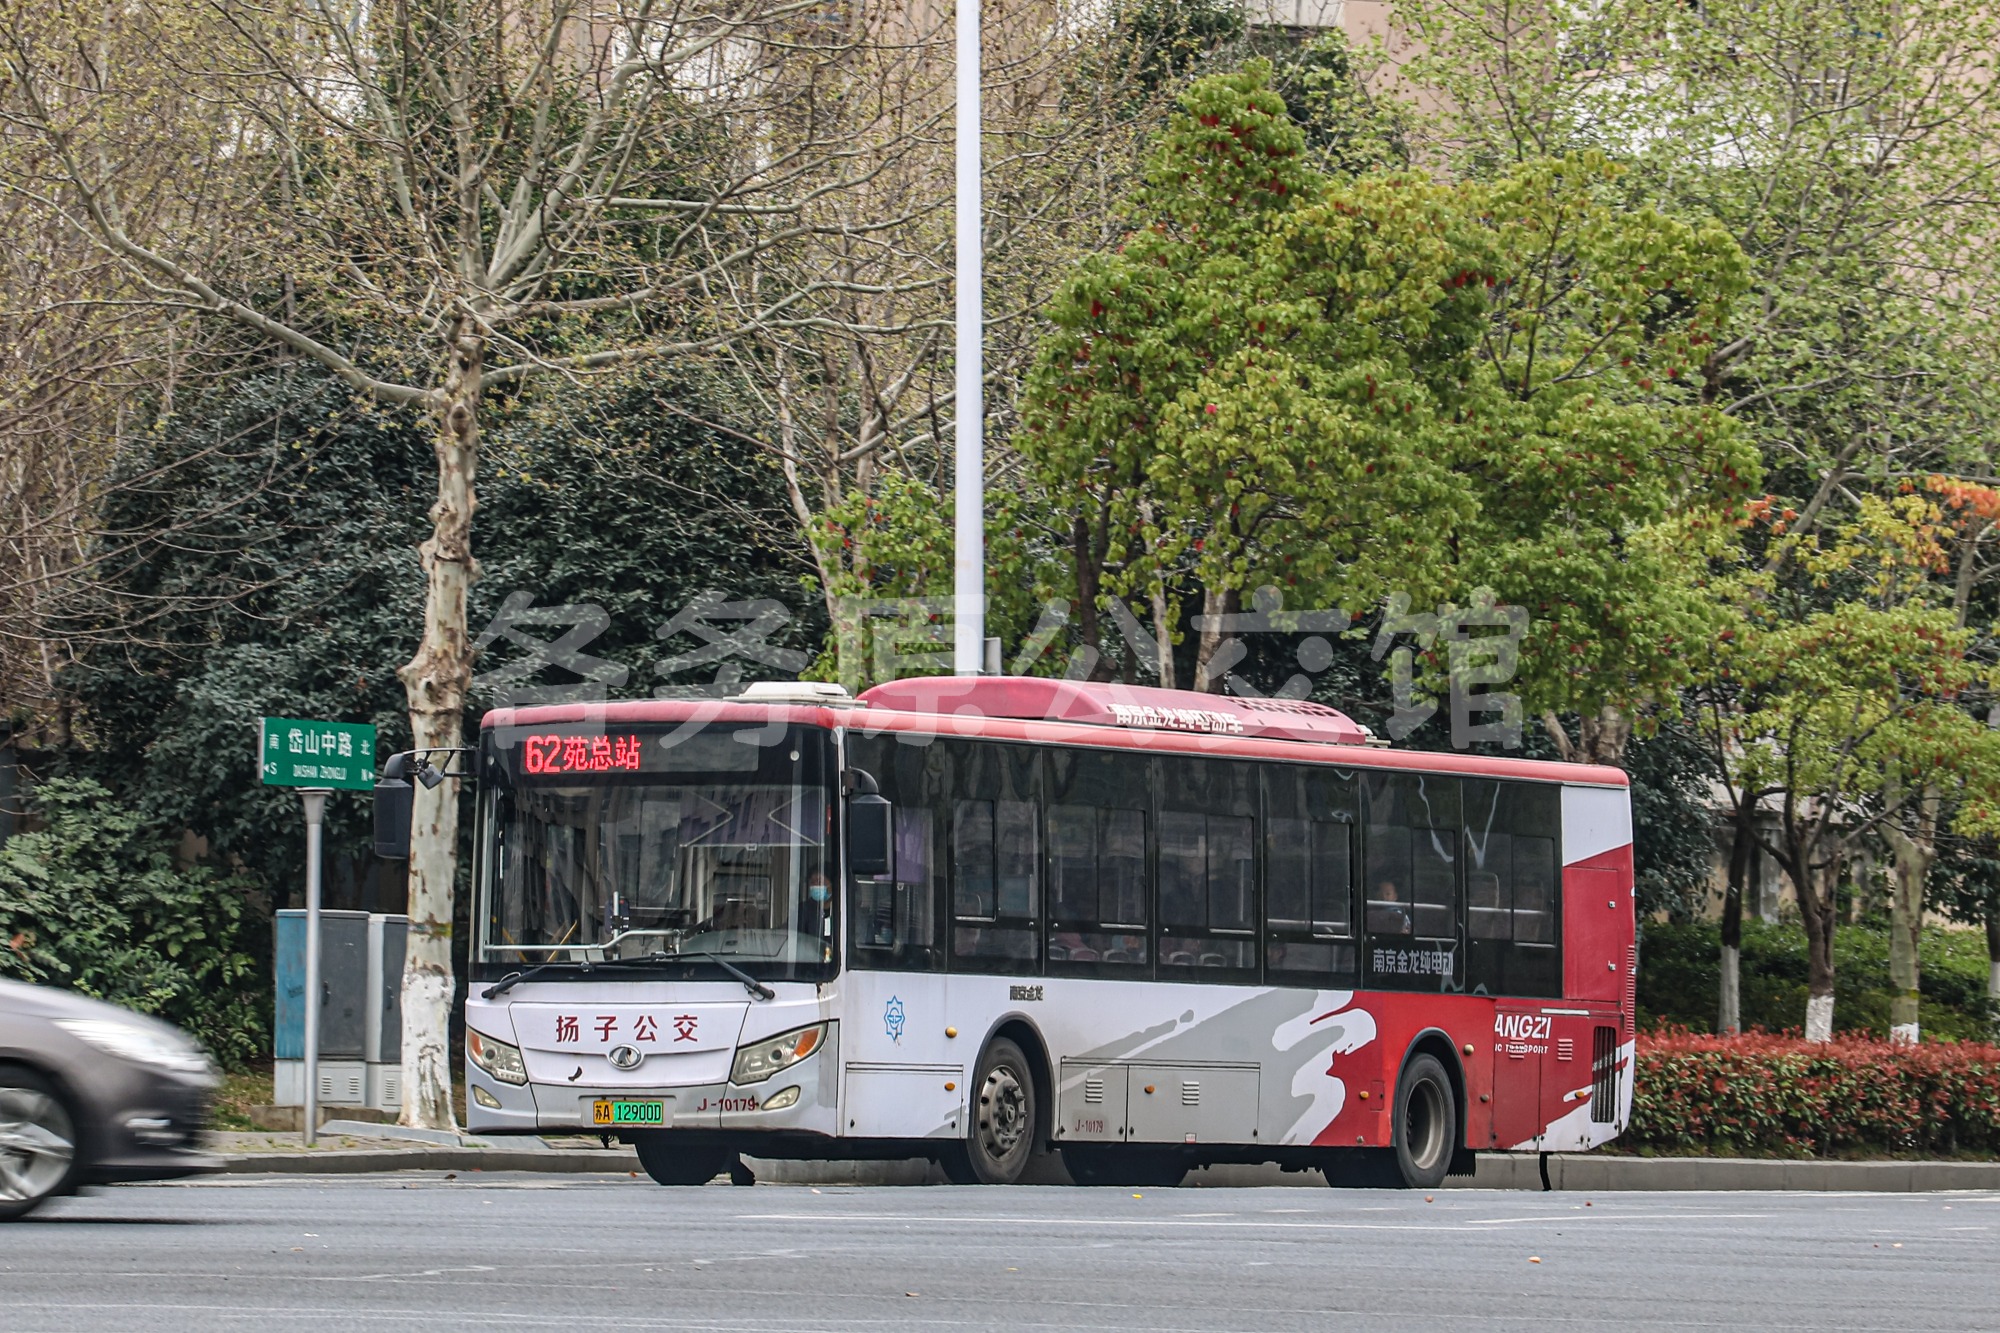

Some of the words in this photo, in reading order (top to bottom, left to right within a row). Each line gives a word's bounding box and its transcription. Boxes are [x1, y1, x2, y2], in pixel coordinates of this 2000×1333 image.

[288, 727, 353, 757] 岱山中路
[269, 762, 278, 775] S
[1373, 948, 1454, 976] 南京金龙纯电动
[556, 1015, 698, 1042] 扬子公交
[697, 1098, 757, 1112] J-10179
[1075, 1119, 1104, 1133] J-10179
